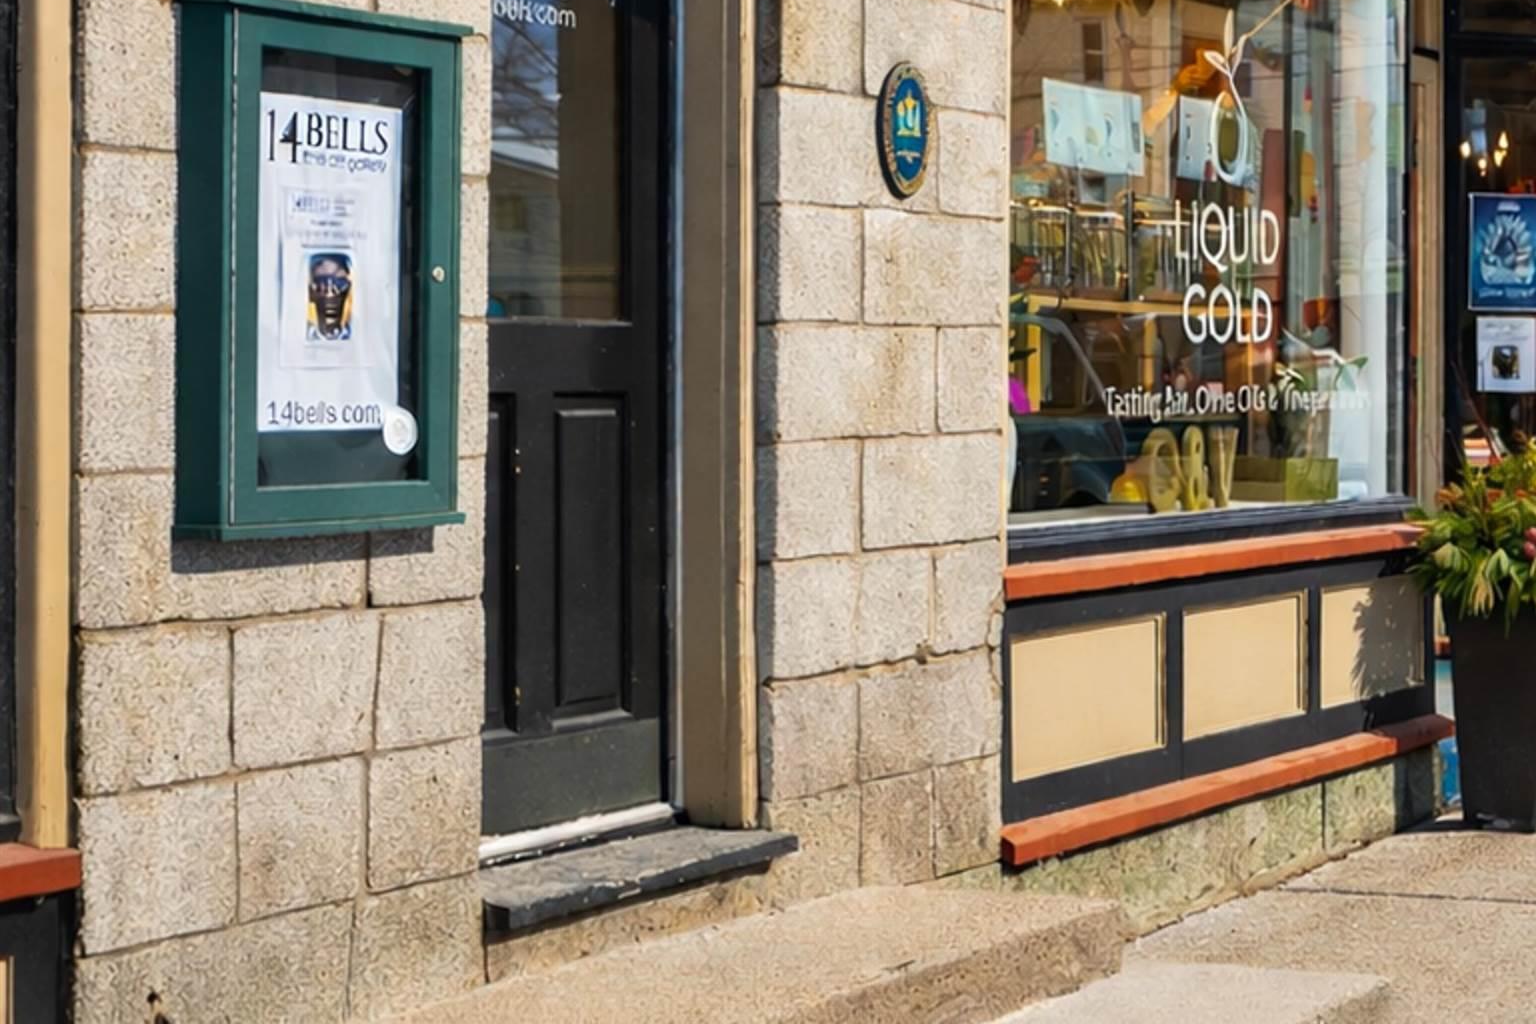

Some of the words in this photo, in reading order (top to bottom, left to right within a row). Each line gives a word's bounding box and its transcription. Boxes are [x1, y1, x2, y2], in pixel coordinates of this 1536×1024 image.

[267, 108, 302, 164] 14
[306, 112, 389, 157] BELLS
[1174, 198, 1281, 272] LIQUID
[1182, 283, 1273, 345] GOLD
